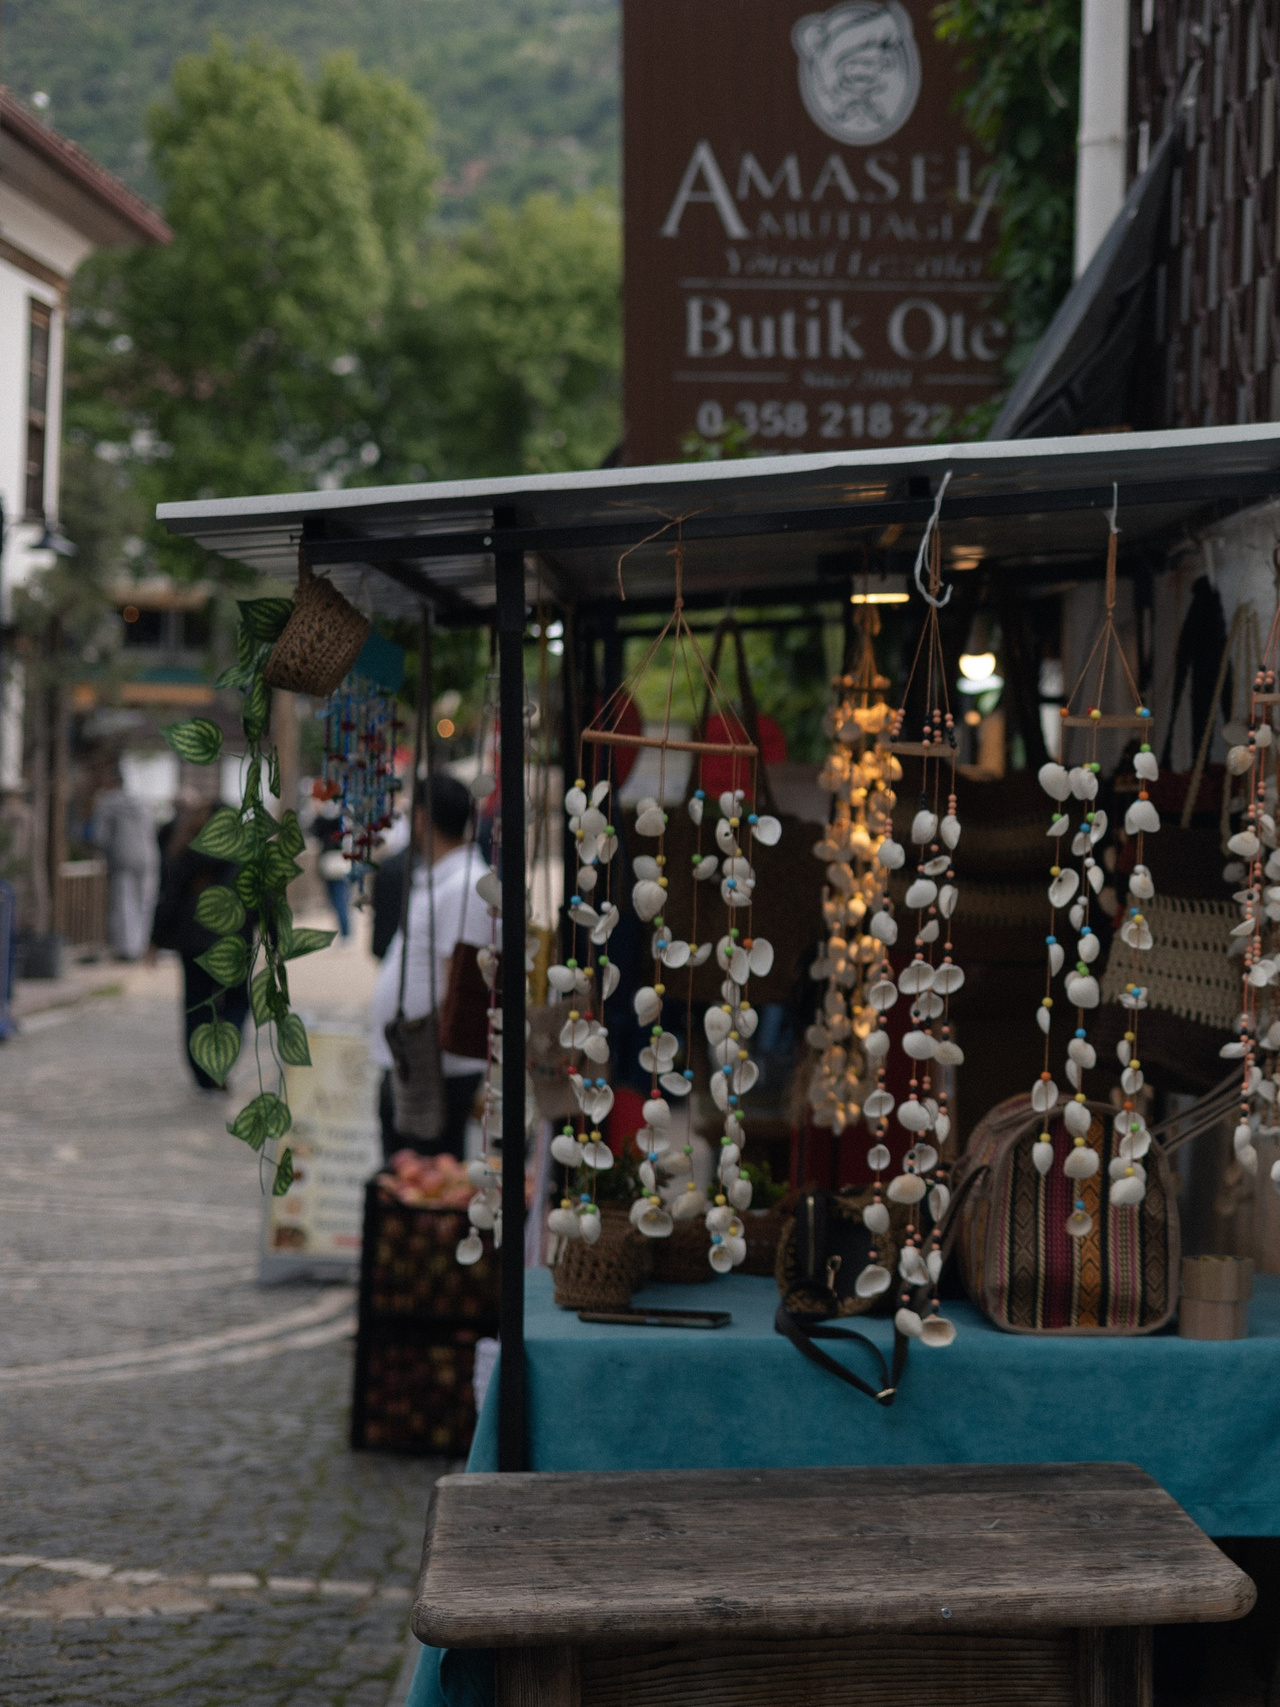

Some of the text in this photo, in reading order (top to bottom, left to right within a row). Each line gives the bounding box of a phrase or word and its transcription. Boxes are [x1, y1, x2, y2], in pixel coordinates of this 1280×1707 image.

[686, 296, 1006, 362] Butik Ote
[696, 401, 724, 438] 0
[734, 401, 808, 439] 358
[819, 401, 894, 440] 218
